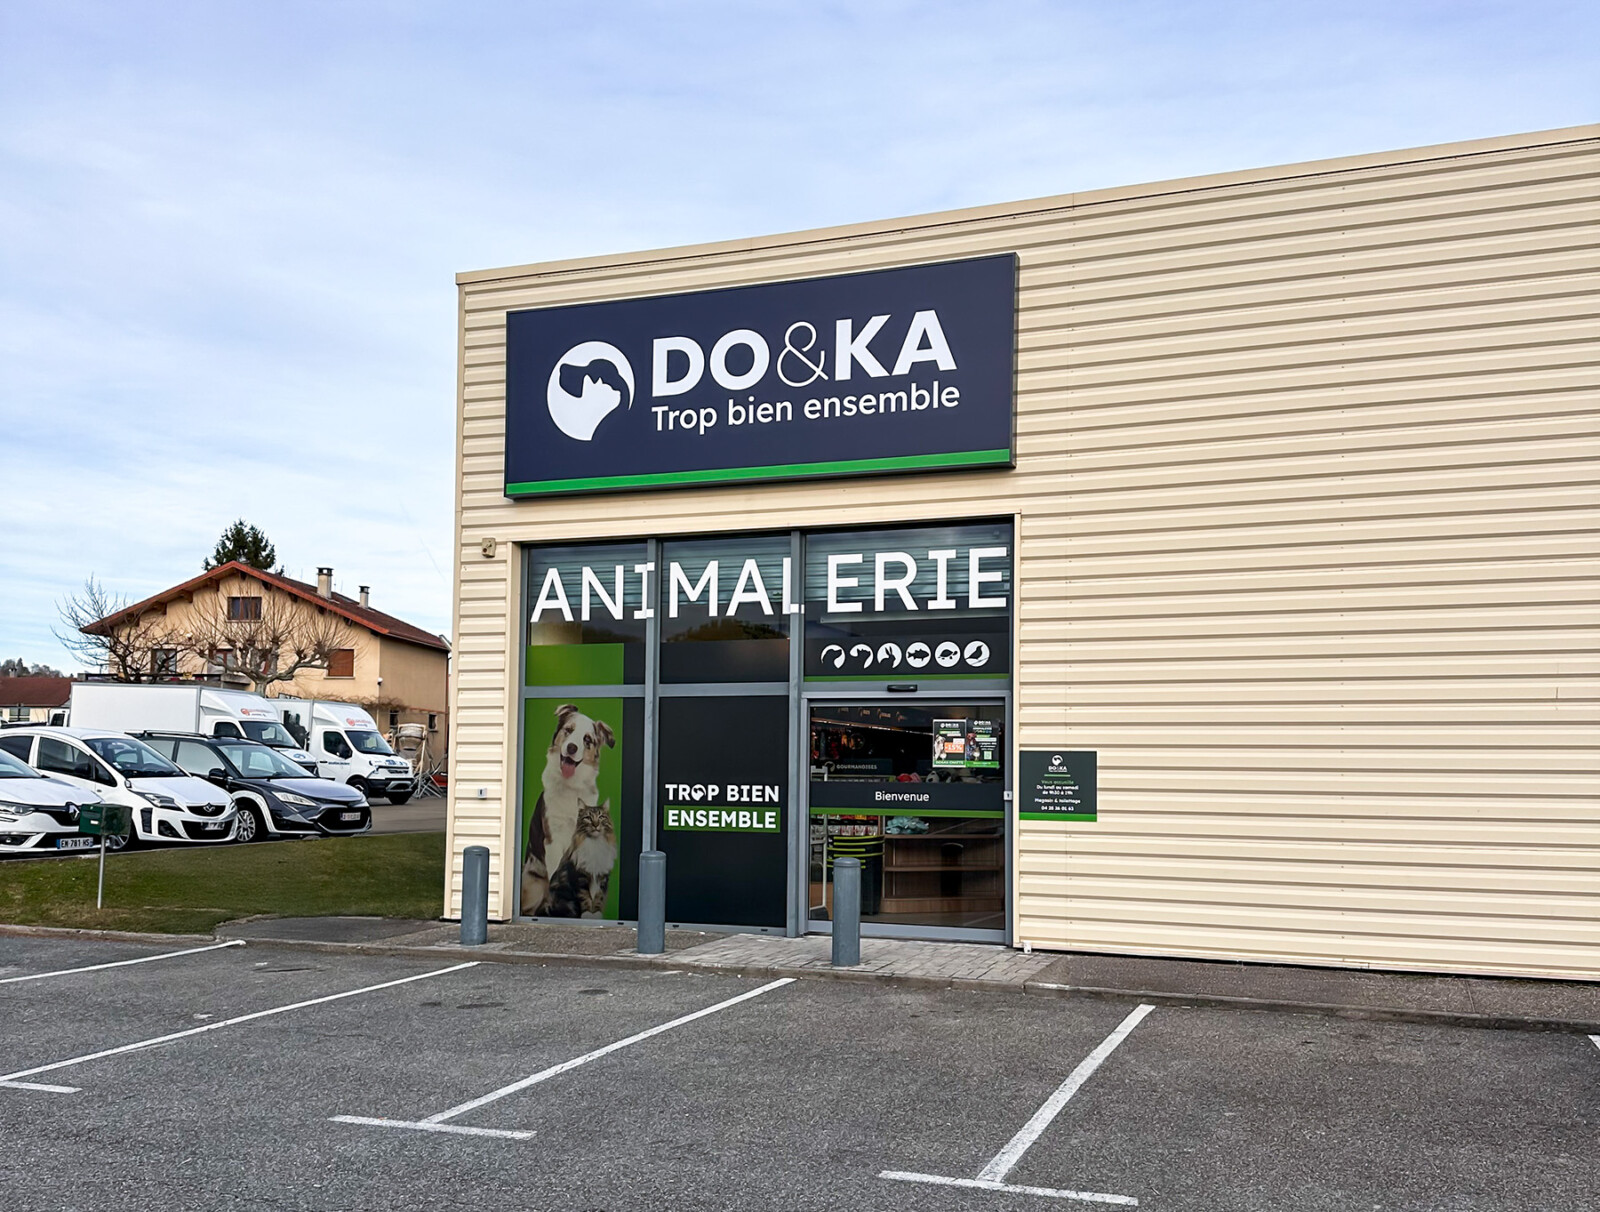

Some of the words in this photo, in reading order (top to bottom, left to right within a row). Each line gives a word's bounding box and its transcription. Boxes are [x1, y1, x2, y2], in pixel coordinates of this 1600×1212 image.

[652, 309, 957, 397] DO&KA
[652, 405, 718, 435] Trop
[728, 396, 793, 426] bien
[803, 380, 960, 420] ensemble
[530, 547, 1007, 623] ANIMALERIE
[665, 784, 720, 801] TROP
[726, 784, 779, 802] BIEN
[875, 791, 930, 802] Bienvenue
[668, 809, 777, 829] ENSEMBLE
